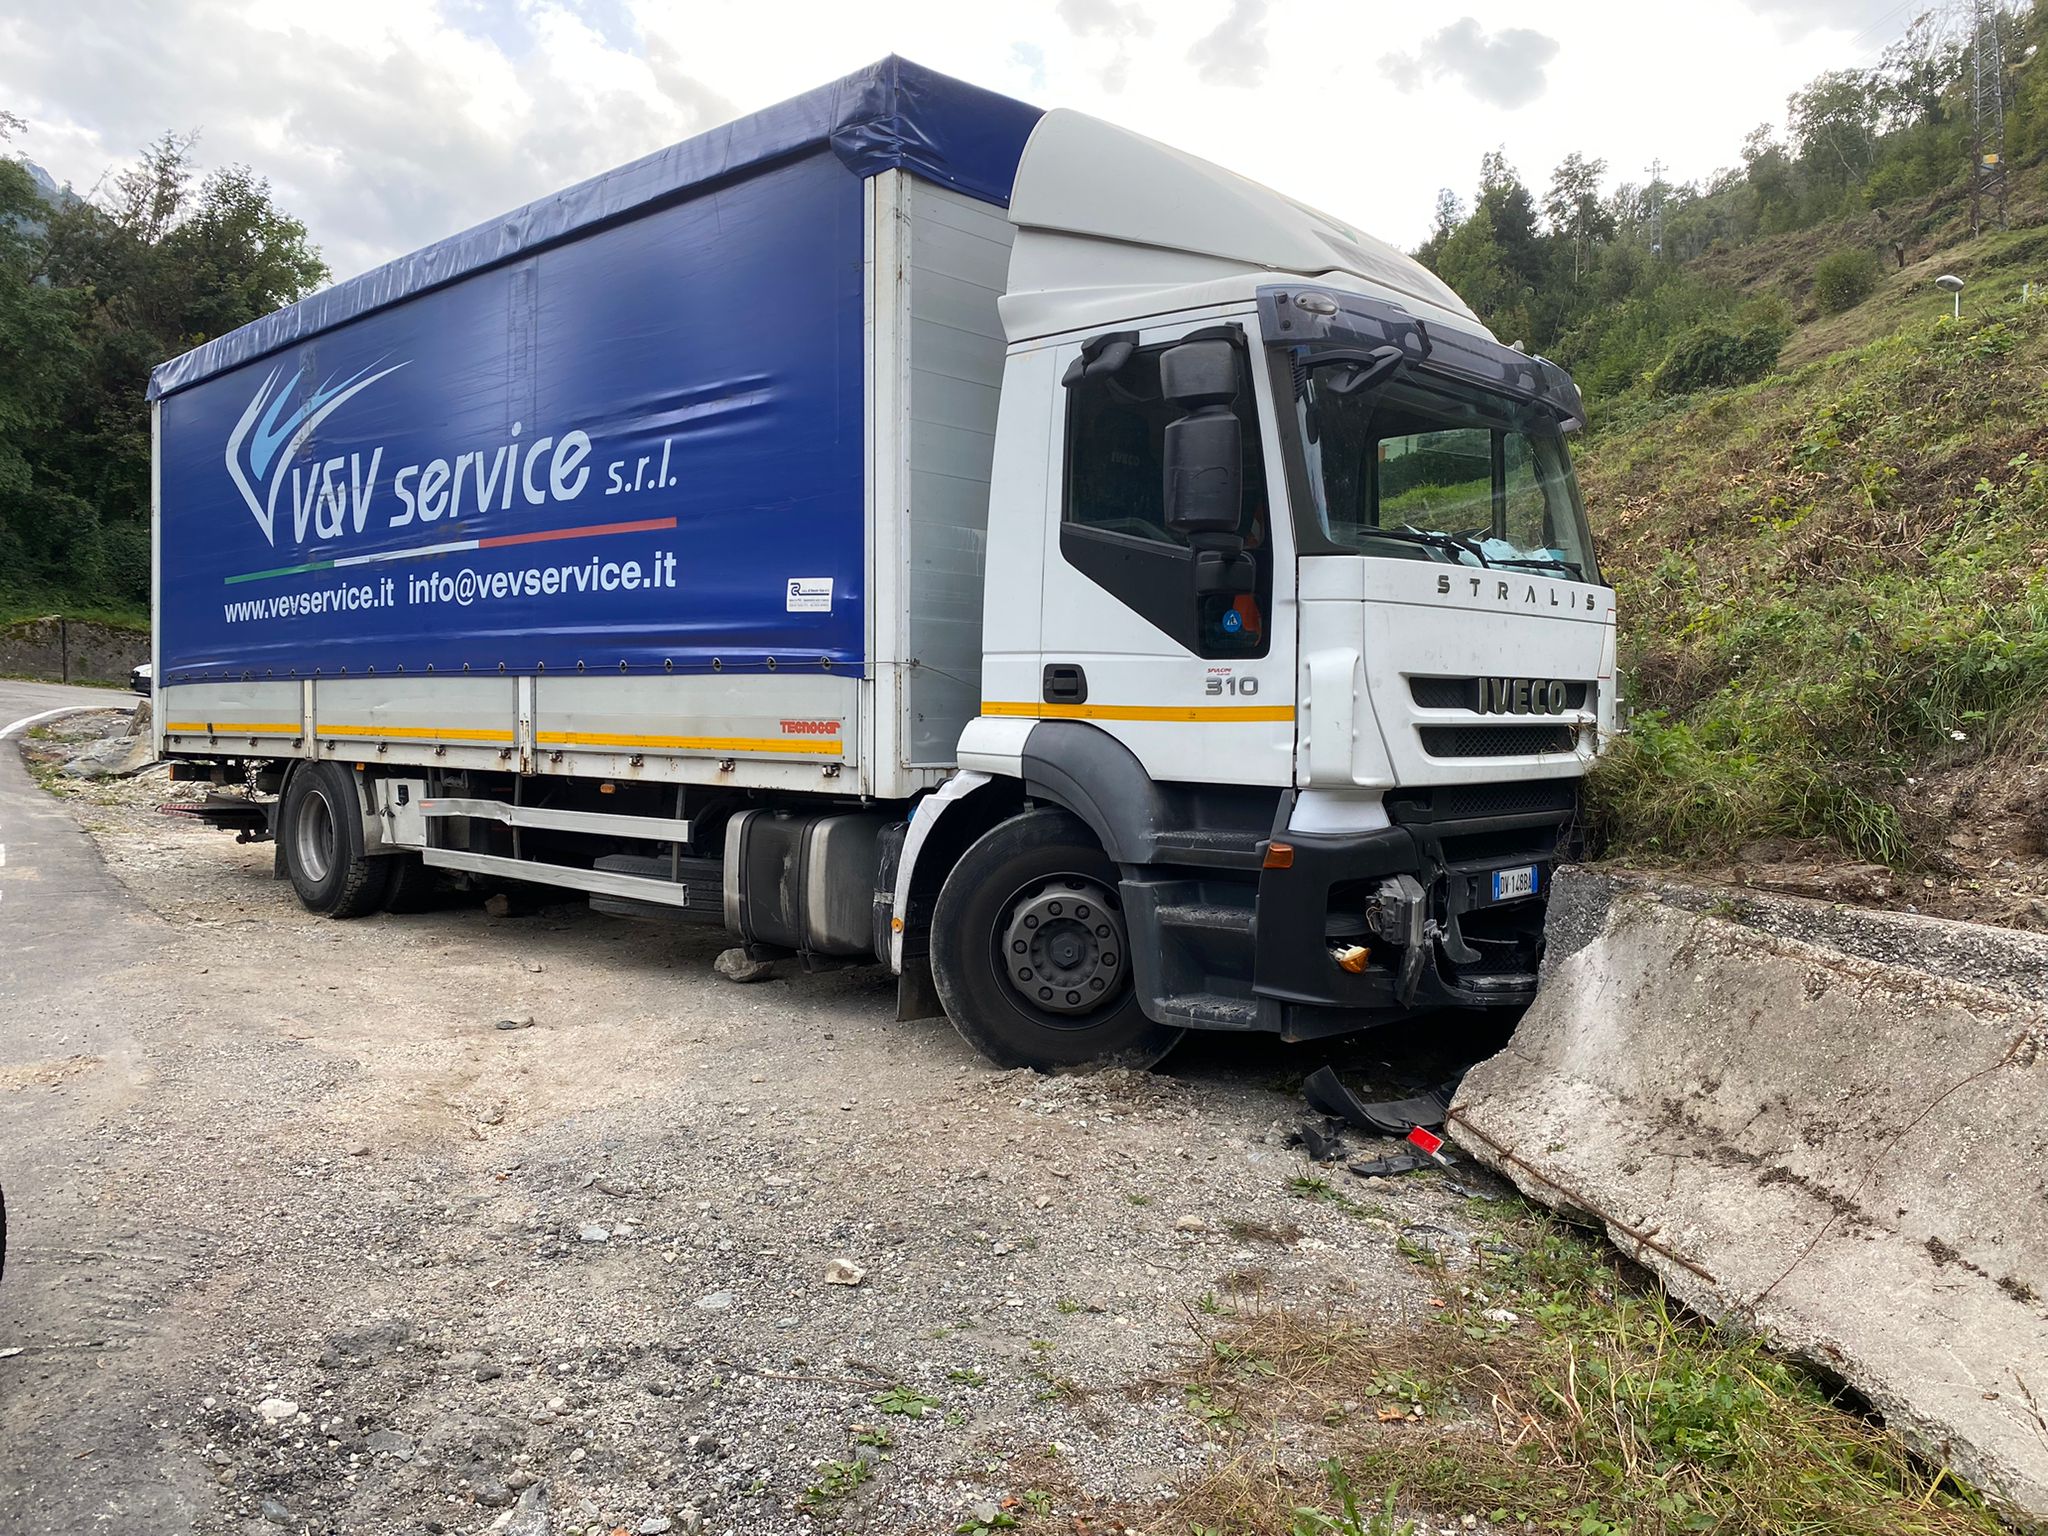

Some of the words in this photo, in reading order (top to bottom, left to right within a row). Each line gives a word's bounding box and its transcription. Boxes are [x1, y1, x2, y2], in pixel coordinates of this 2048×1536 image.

[292, 446, 384, 544] V&V
[388, 421, 592, 528] service
[605, 438, 678, 495] s.r.l.
[224, 577, 395, 623] www.vevservice.it
[409, 550, 677, 606] info@vevservice.it
[1437, 574, 1595, 611] STRALIS
[1205, 676, 1259, 696] 310
[1478, 676, 1568, 716] IVECO
